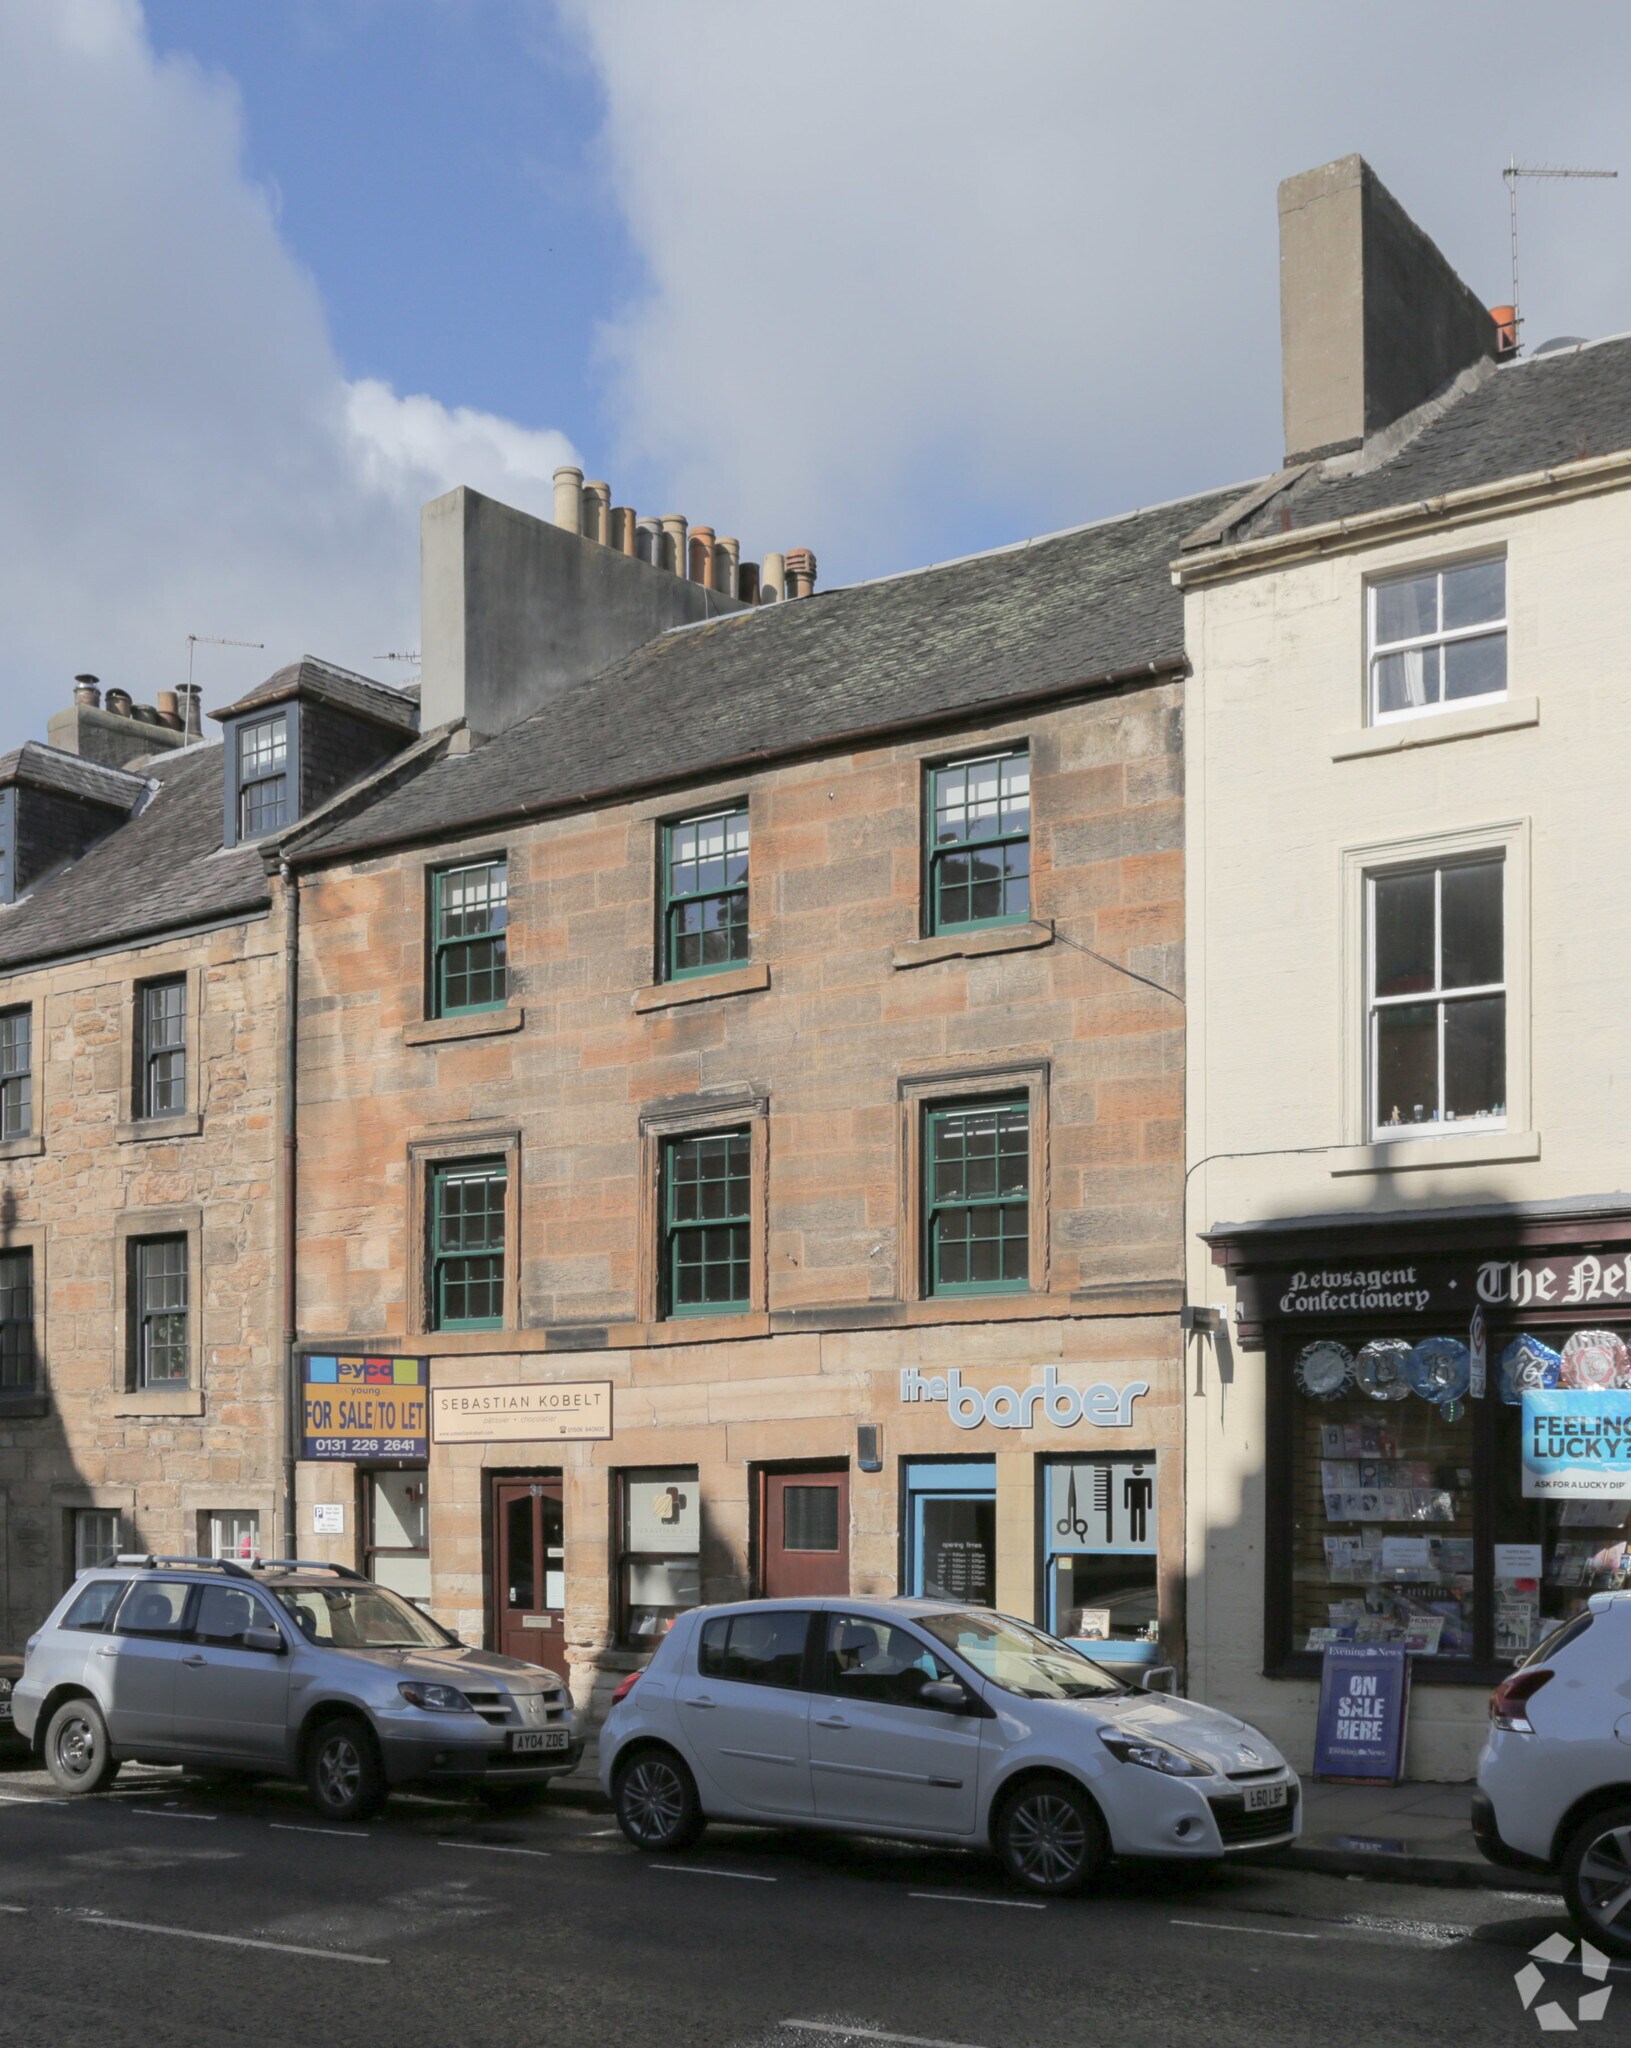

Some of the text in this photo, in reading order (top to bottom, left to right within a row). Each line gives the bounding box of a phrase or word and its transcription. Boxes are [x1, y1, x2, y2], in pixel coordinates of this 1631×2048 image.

[1288, 1266, 1417, 1291] Newsagent
[1476, 1260, 1558, 1306] The
[1279, 1289, 1430, 1313] Confectionery
[338, 1362, 392, 1378] eyco
[441, 1393, 602, 1411] SEBASTIAN KOBELT
[900, 1365, 1149, 1429] the barber
[304, 1400, 332, 1429] FOR
[401, 1402, 424, 1430] LET
[520, 1415, 557, 1424] chocolatier
[315, 1439, 415, 1451] 0131 226 2641
[1329, 1646, 1402, 1658] Evening News
[1349, 1675, 1377, 1696] ON
[1337, 1697, 1385, 1718] SALE
[1336, 1719, 1383, 1741] HERE
[517, 1733, 565, 1749] AY04 ZDE
[1367, 1748, 1386, 1756] News
[1250, 1789, 1267, 1807] L60
